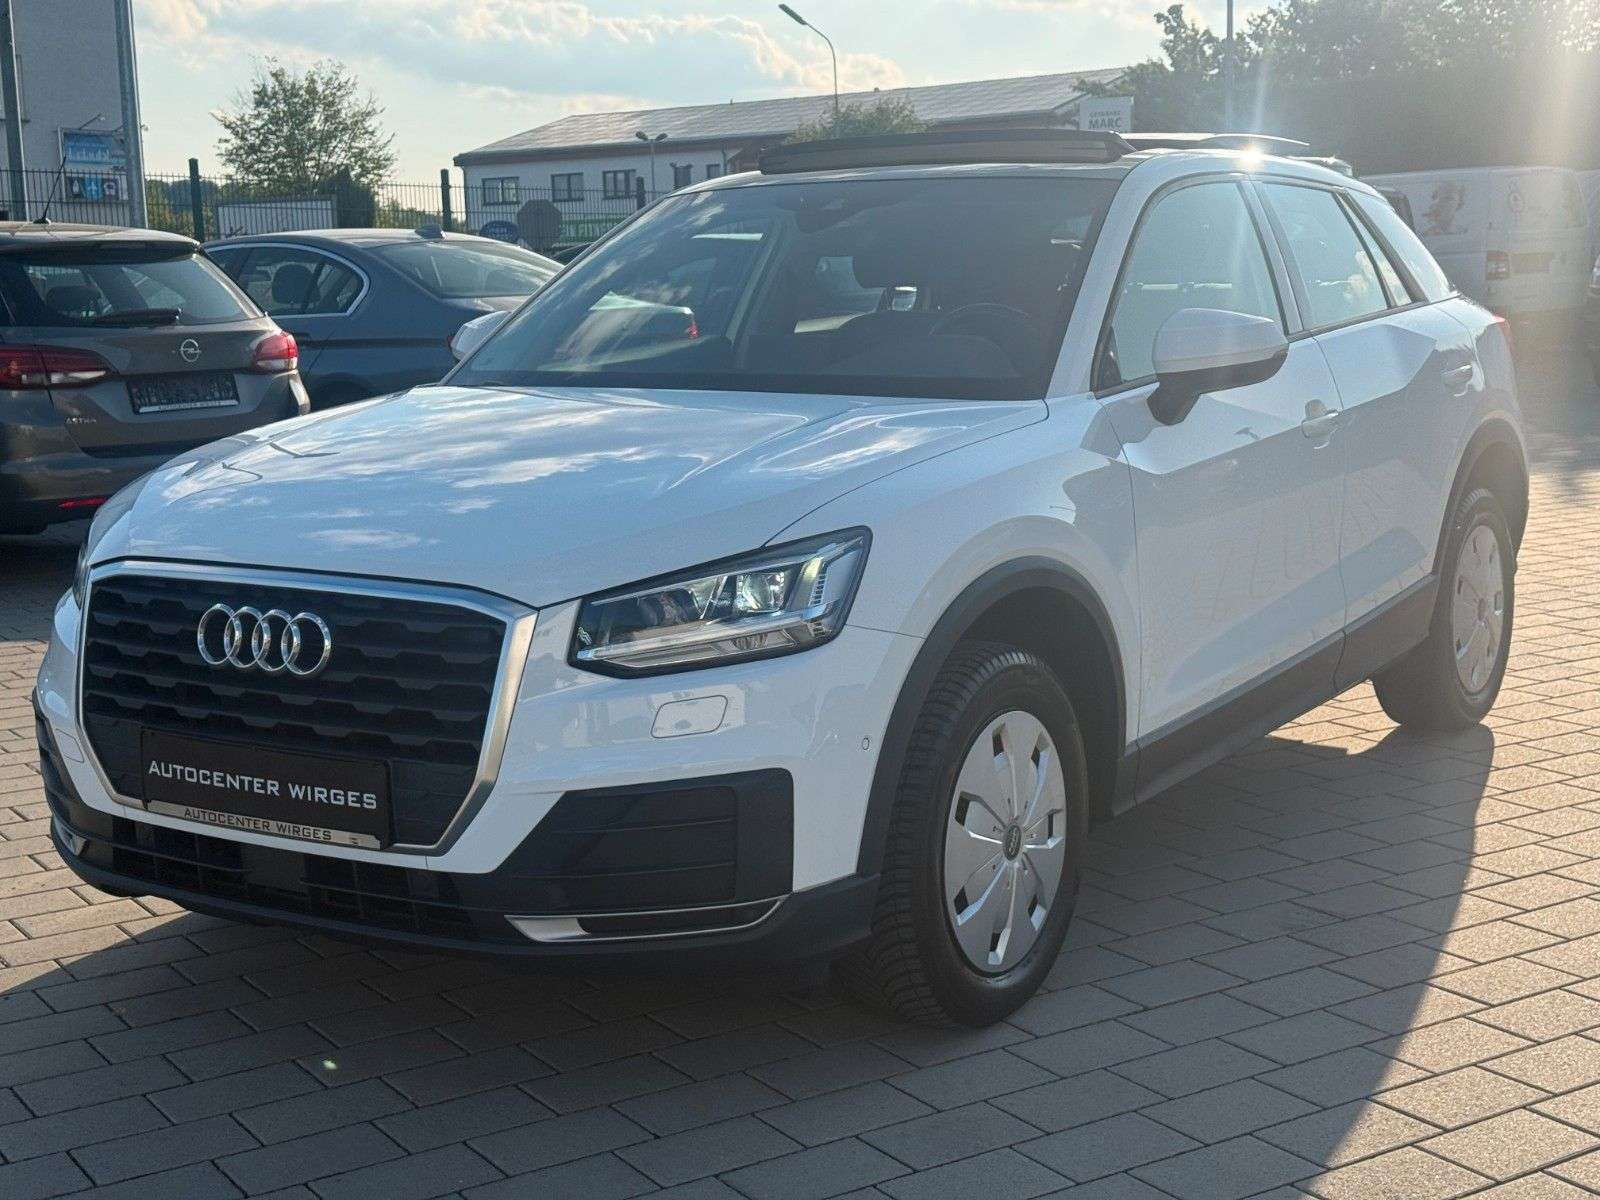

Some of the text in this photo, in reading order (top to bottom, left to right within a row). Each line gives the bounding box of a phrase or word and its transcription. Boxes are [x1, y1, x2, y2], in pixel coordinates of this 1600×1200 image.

[148, 760, 377, 810] AUTOCENTER WIRGES
[184, 808, 332, 841] AUTOCENTER WIRGES
